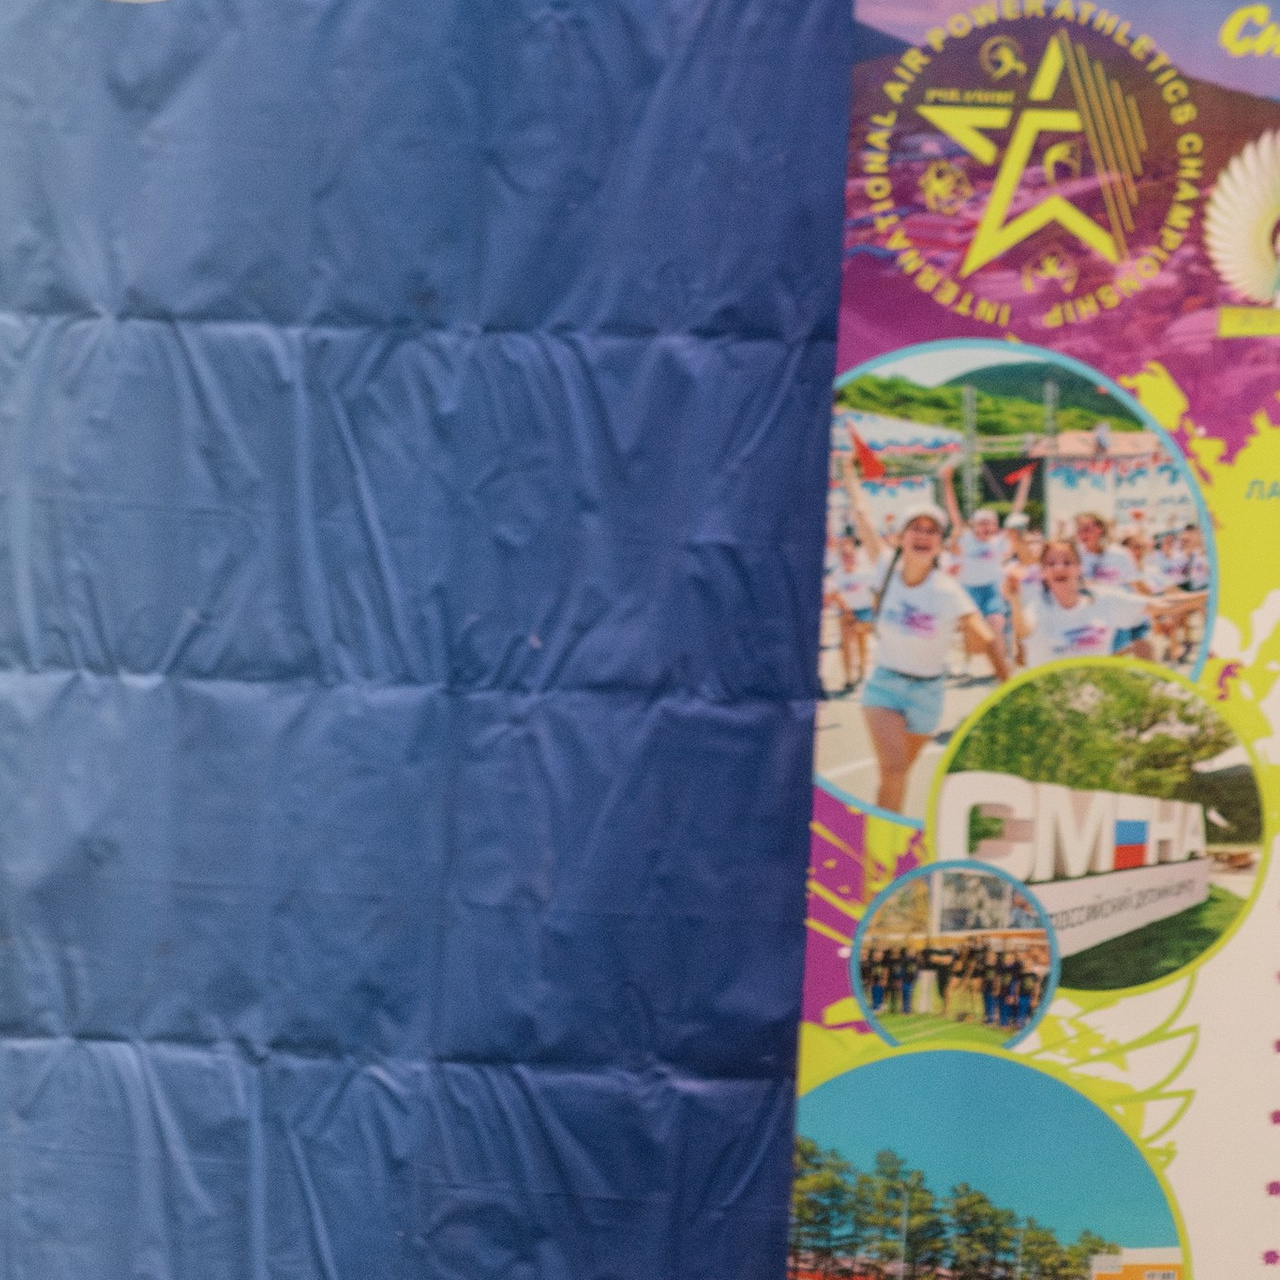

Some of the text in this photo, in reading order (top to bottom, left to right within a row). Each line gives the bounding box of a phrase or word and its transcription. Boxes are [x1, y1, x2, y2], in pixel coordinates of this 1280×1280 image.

[882, 46, 932, 104] AIR
[863, 109, 1013, 328] INTERNATIONAL
[1043, 131, 1205, 328] CHAMPIONSHIP
